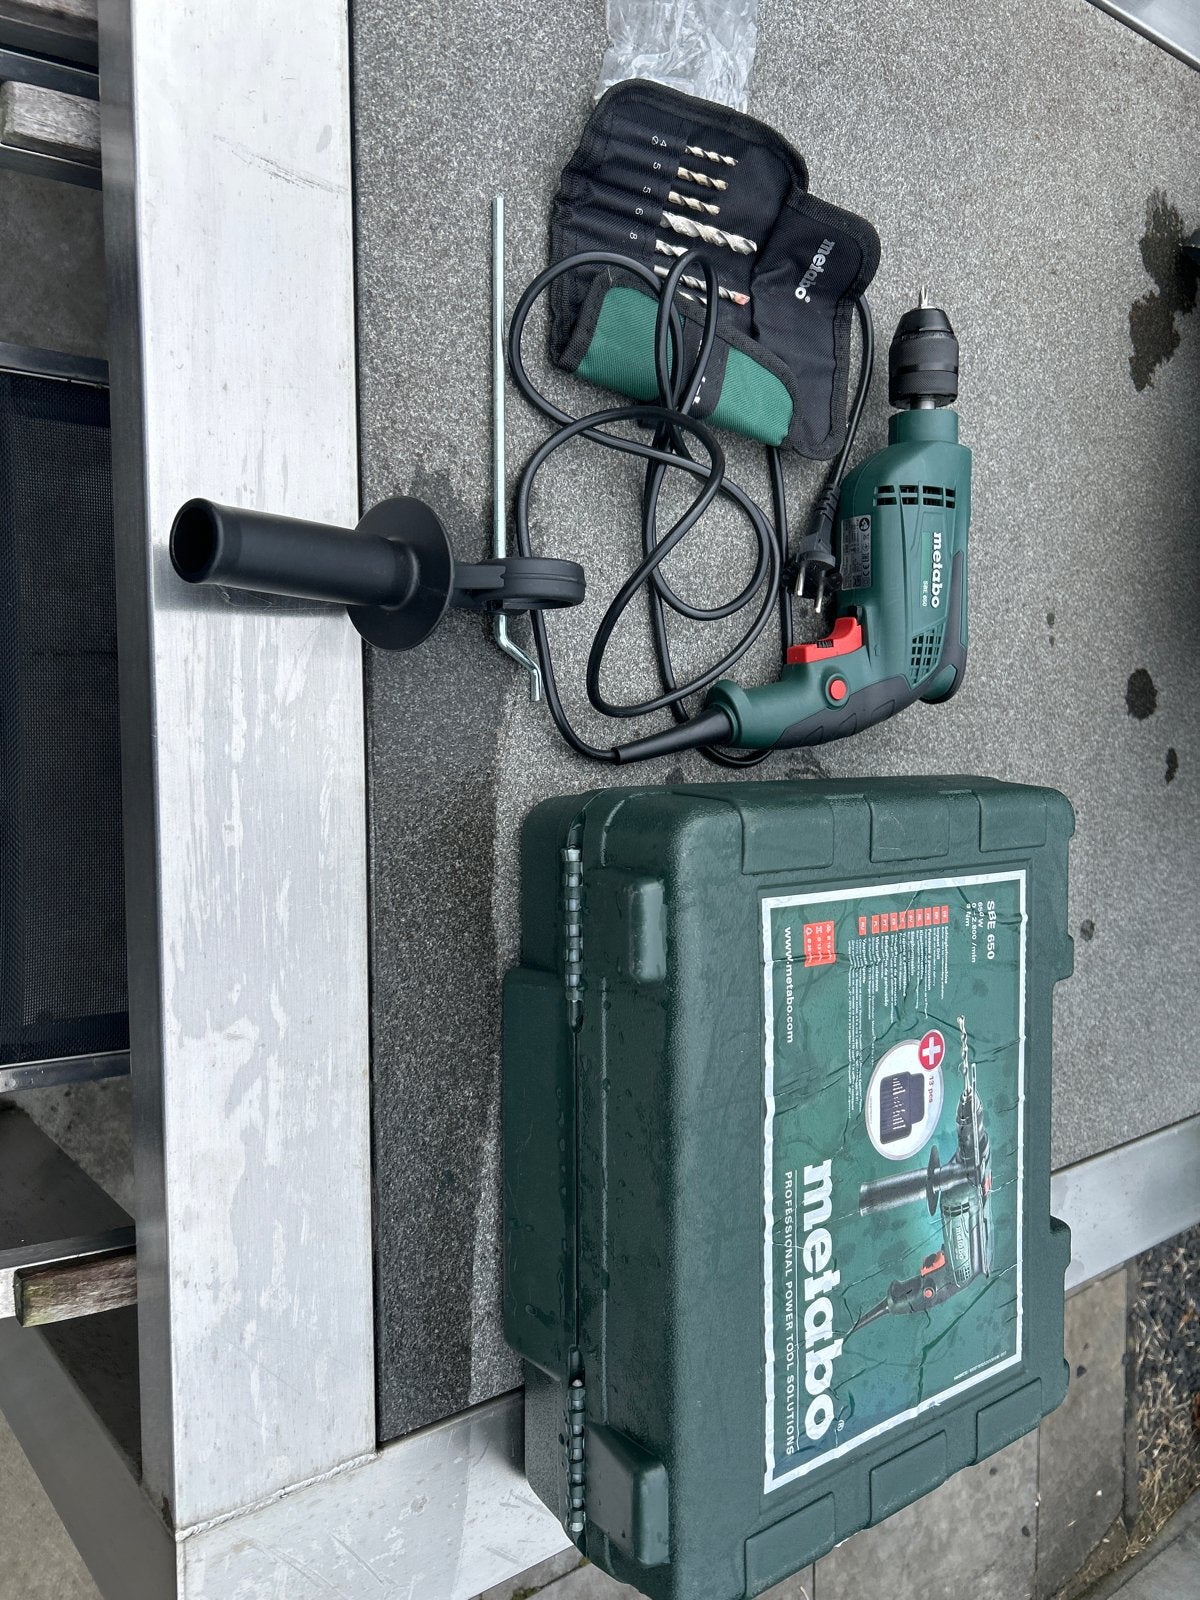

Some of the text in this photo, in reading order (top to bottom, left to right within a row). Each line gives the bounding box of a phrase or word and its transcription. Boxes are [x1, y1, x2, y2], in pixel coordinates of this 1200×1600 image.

[652, 161, 661, 170] 5
[642, 186, 651, 194] 5
[629, 232, 638, 240] 8
[931, 531, 943, 609] metabo
[965, 910, 971, 926] Nm
[986, 899, 996, 930] SBE
[978, 918, 982, 928] W
[785, 926, 794, 1043] www.metabo.com
[928, 1075, 933, 1086] 13
[784, 1170, 794, 1457] PROFESSIONAL POWER TOOL SOLUTIONS
